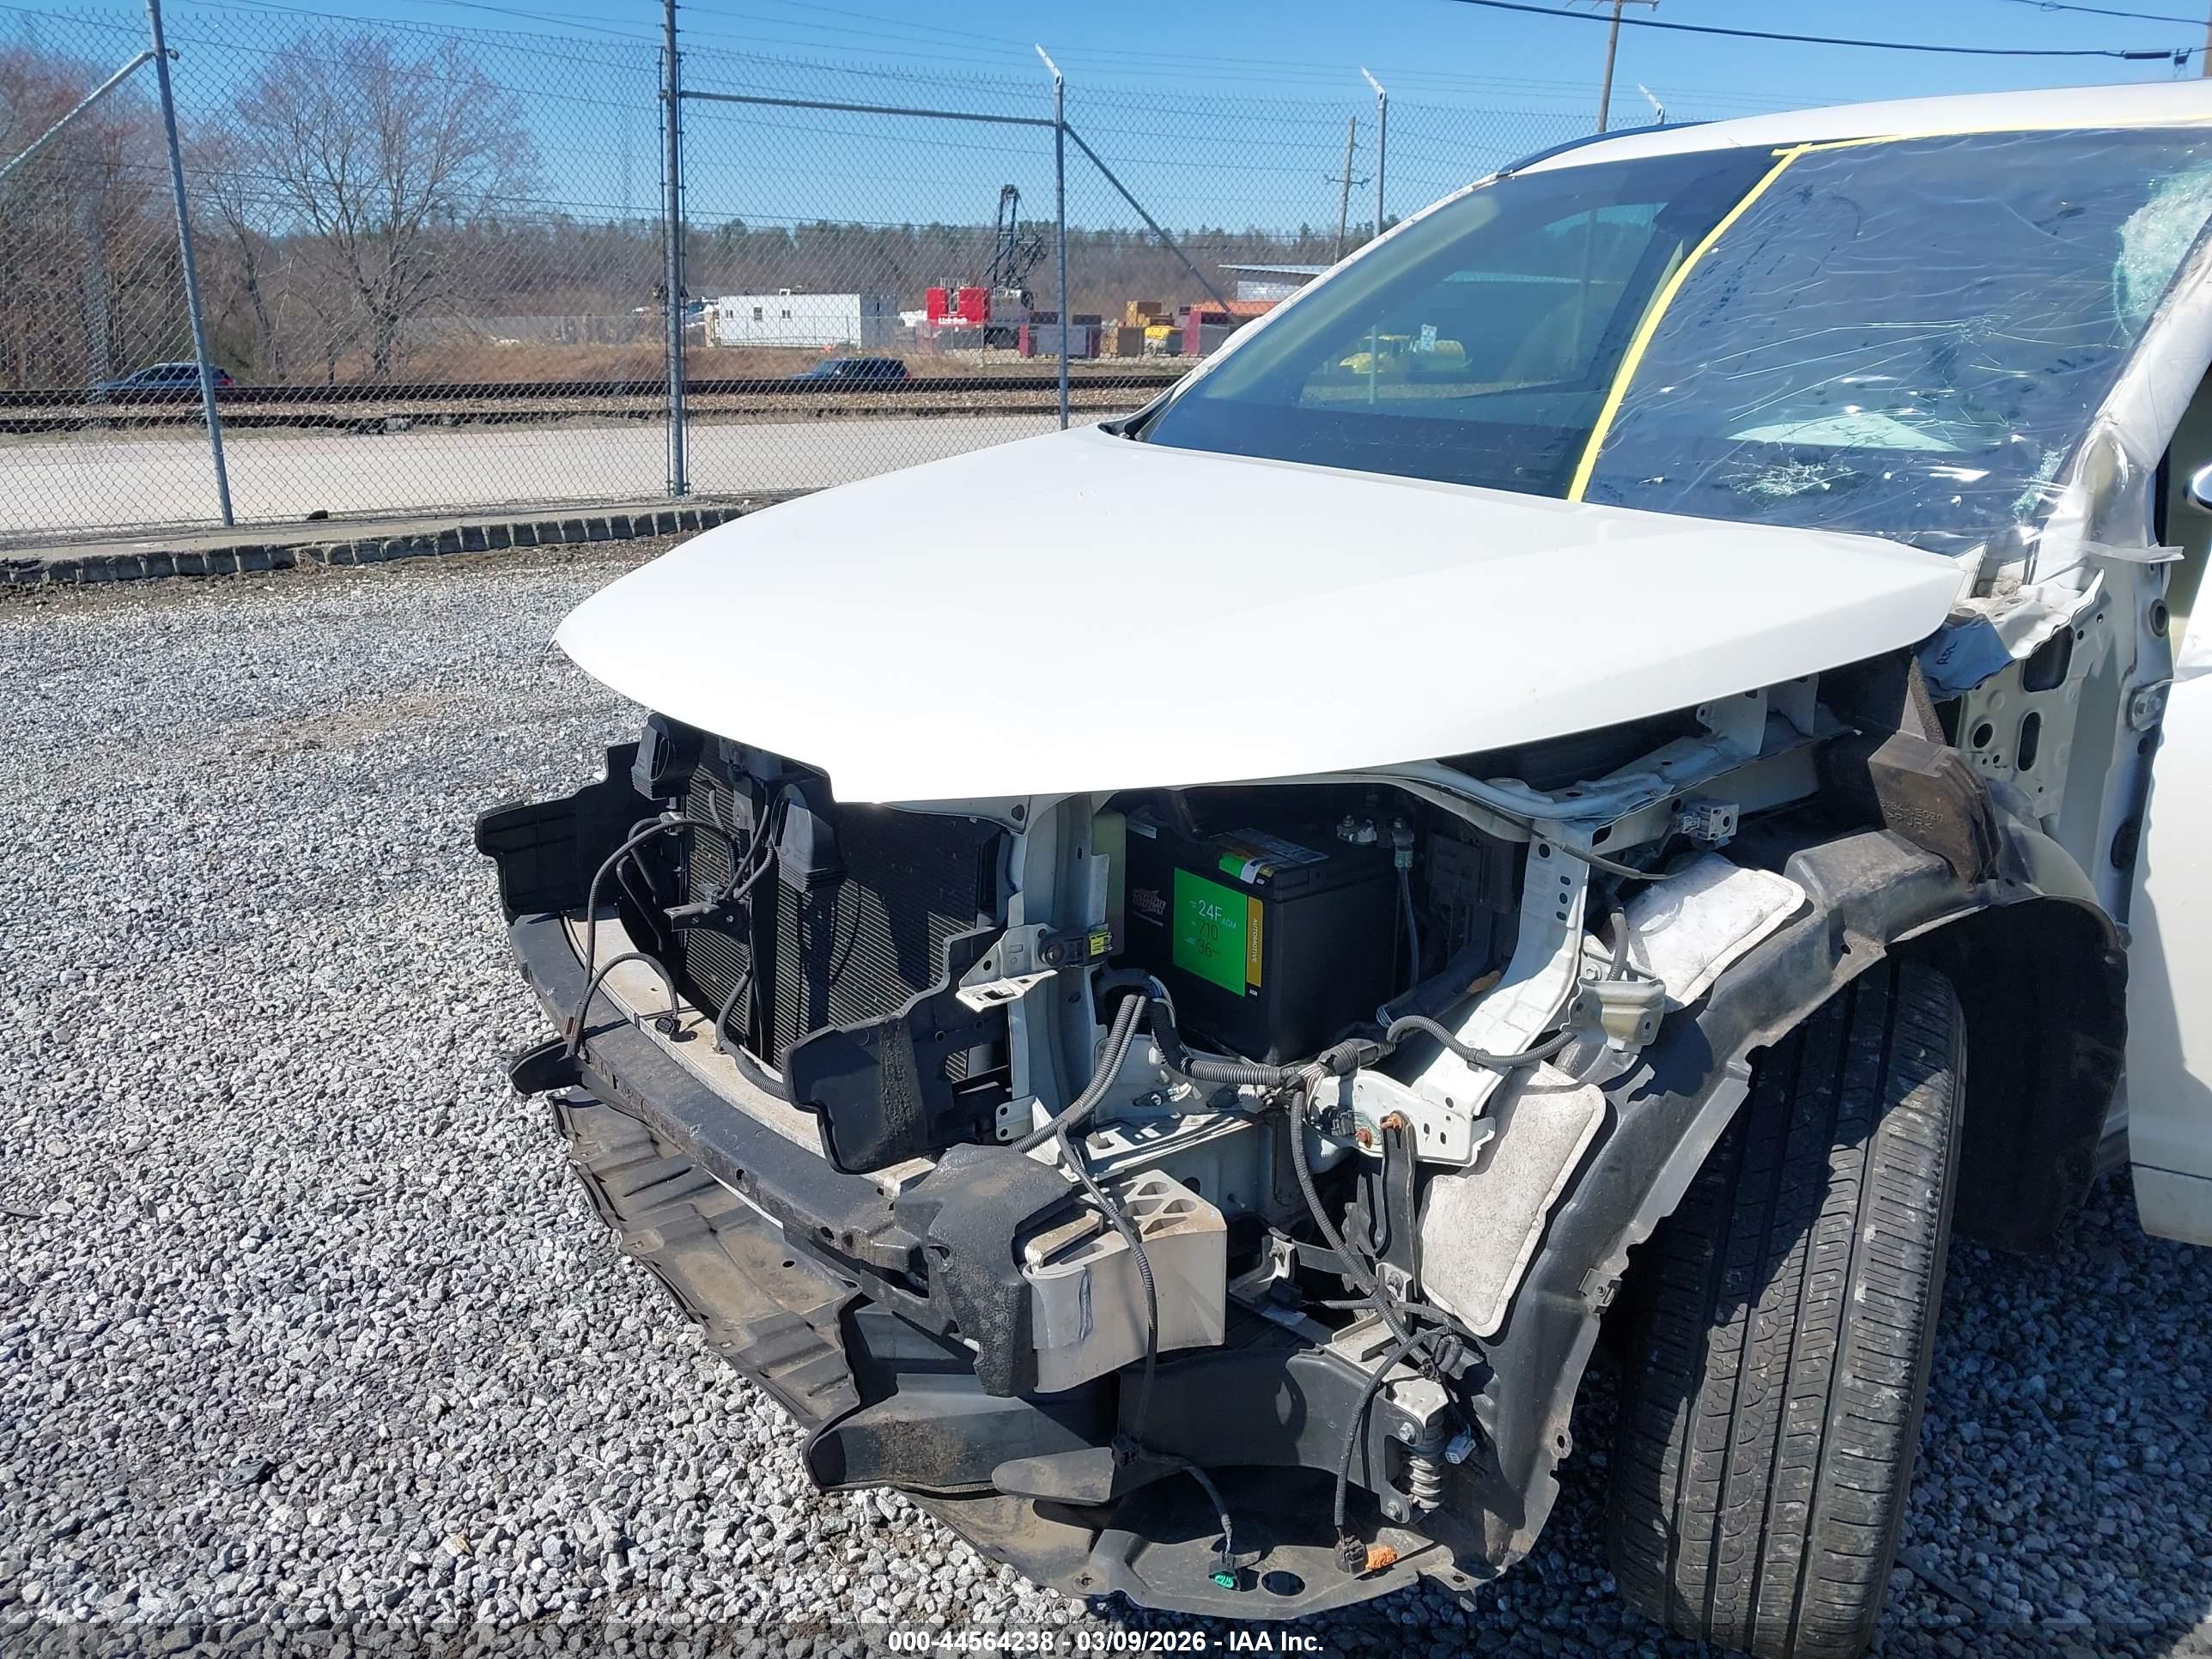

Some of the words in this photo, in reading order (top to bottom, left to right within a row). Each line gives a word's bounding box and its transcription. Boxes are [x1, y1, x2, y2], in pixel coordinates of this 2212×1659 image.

[1198, 899, 1223, 921] 24F
[1195, 916, 1218, 940] 710
[1196, 939, 1212, 957] 36
